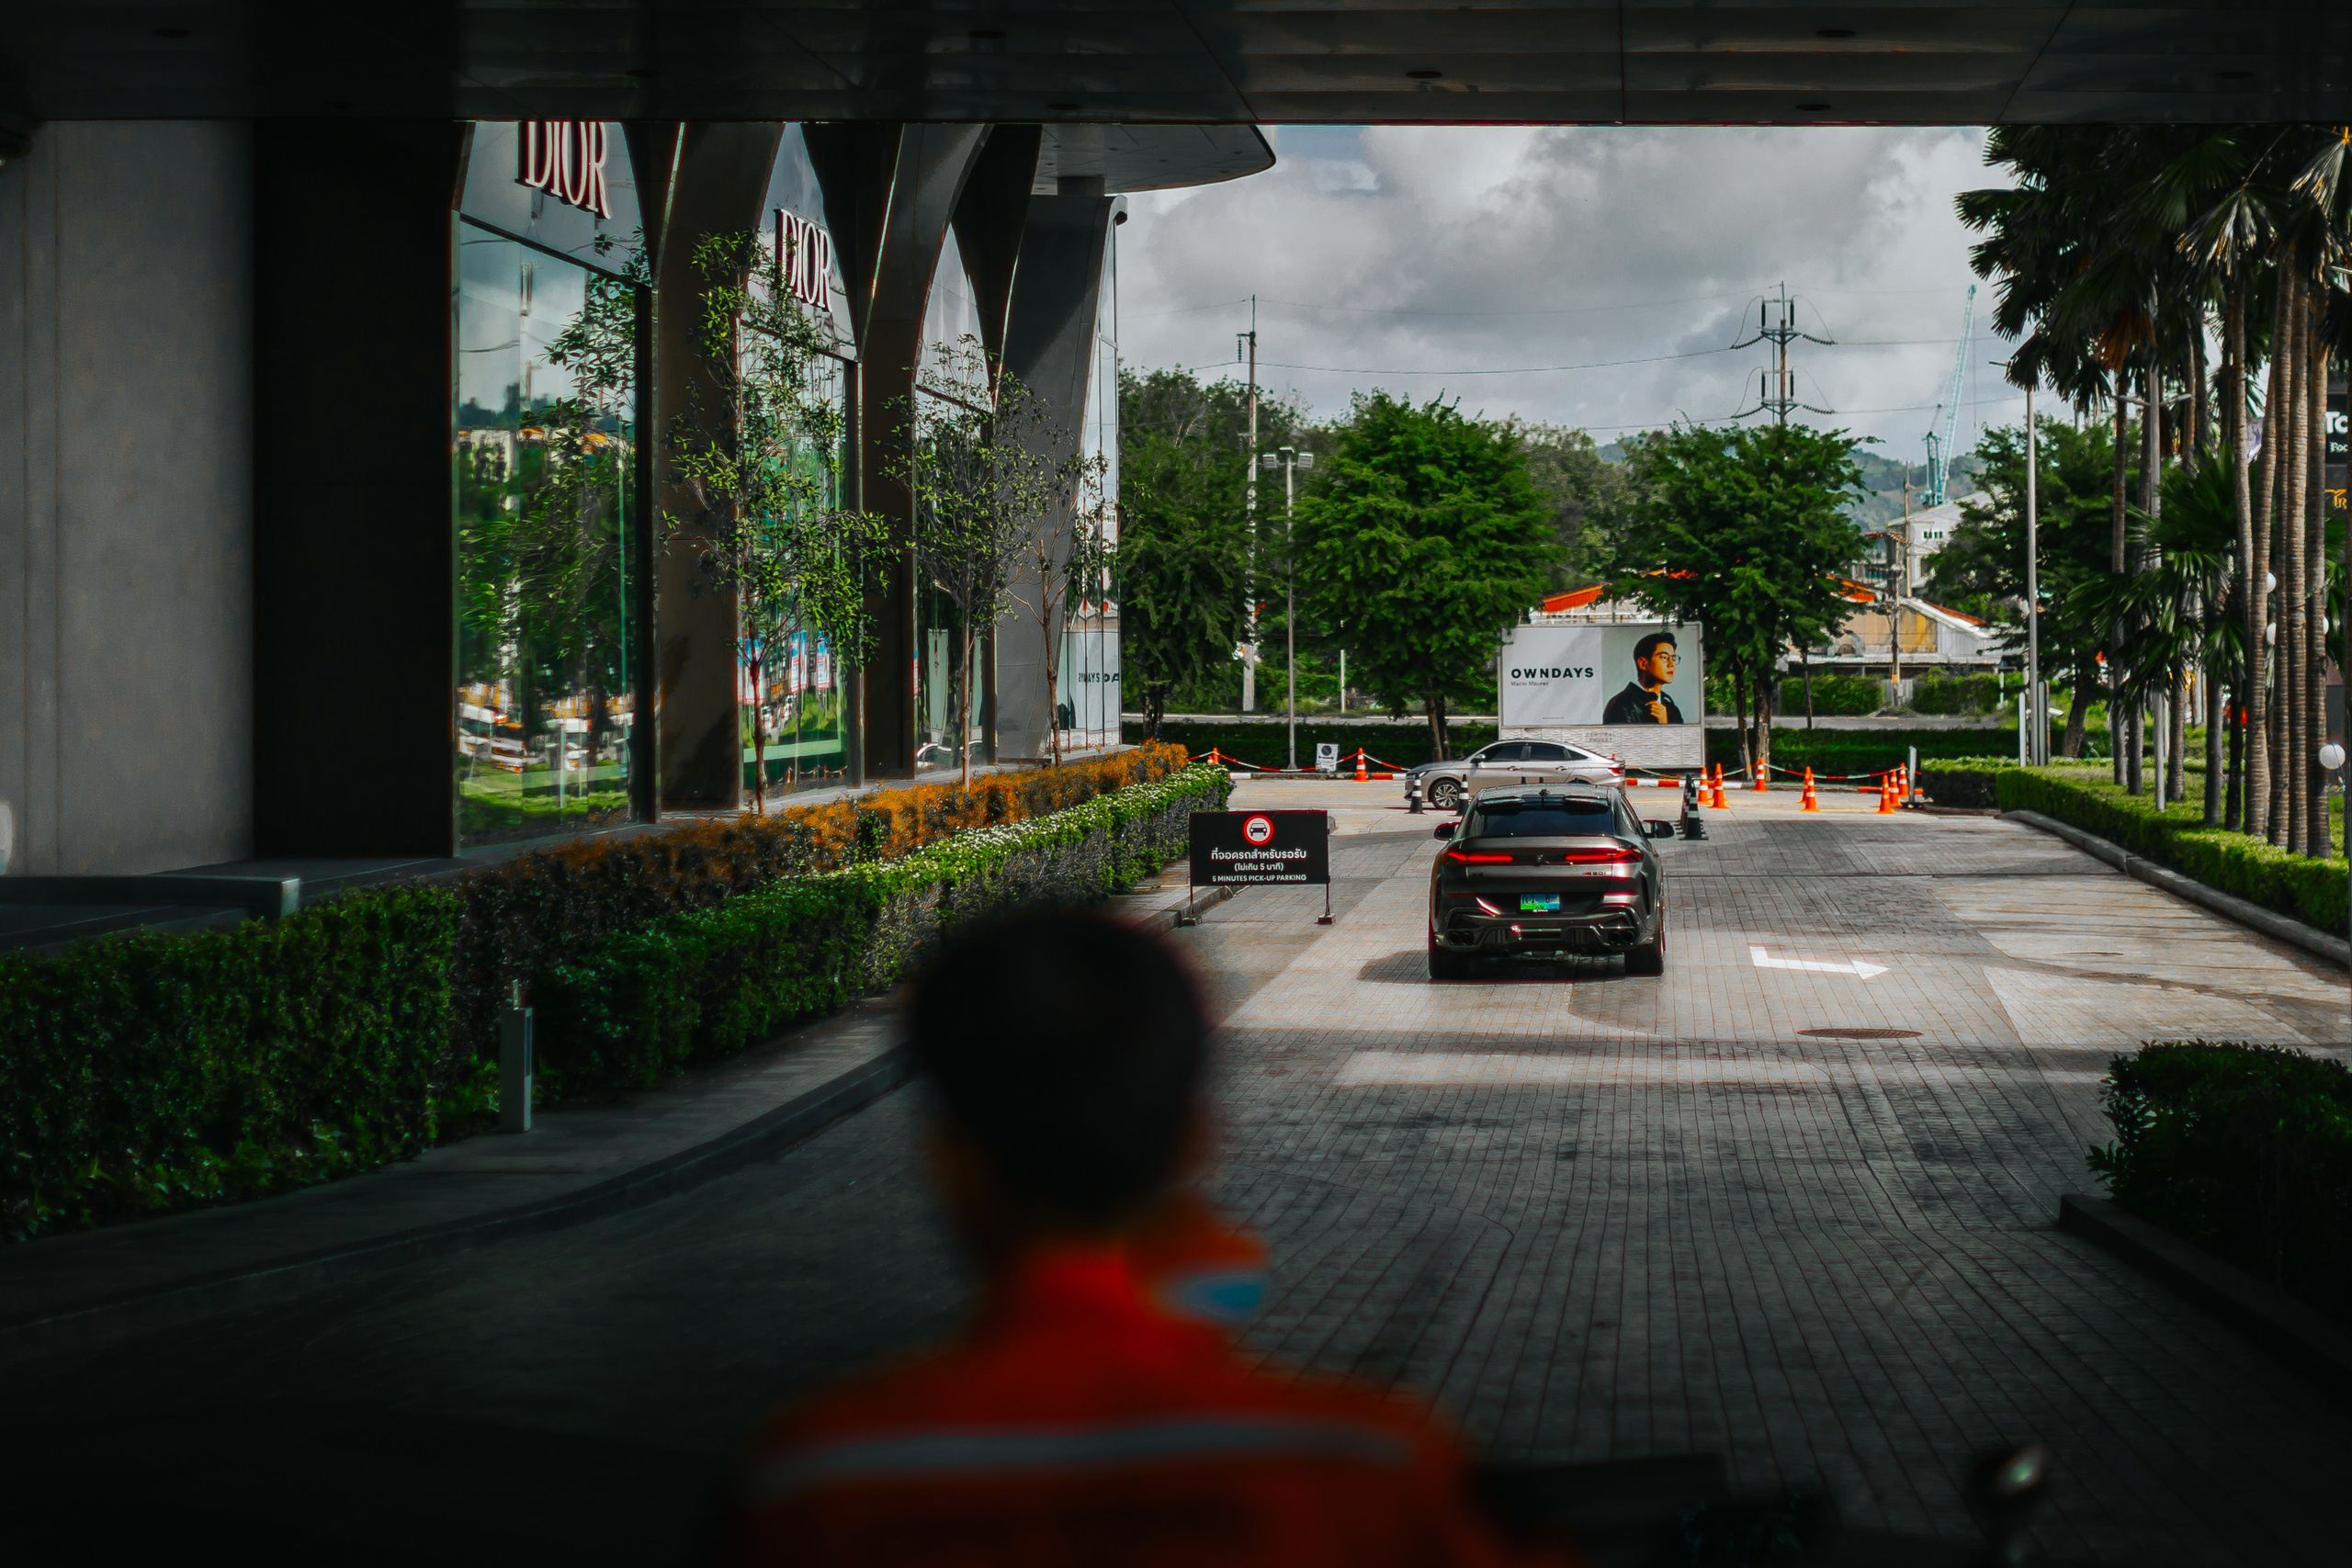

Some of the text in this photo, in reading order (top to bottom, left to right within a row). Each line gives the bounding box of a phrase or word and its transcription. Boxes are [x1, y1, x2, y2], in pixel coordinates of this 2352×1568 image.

[524, 121, 611, 220] DIOR
[780, 209, 832, 312] DIOR
[1510, 667, 1594, 679] OWNDAYS
[1211, 847, 1306, 860] ที่จอดรถสำหรับรอรับ
